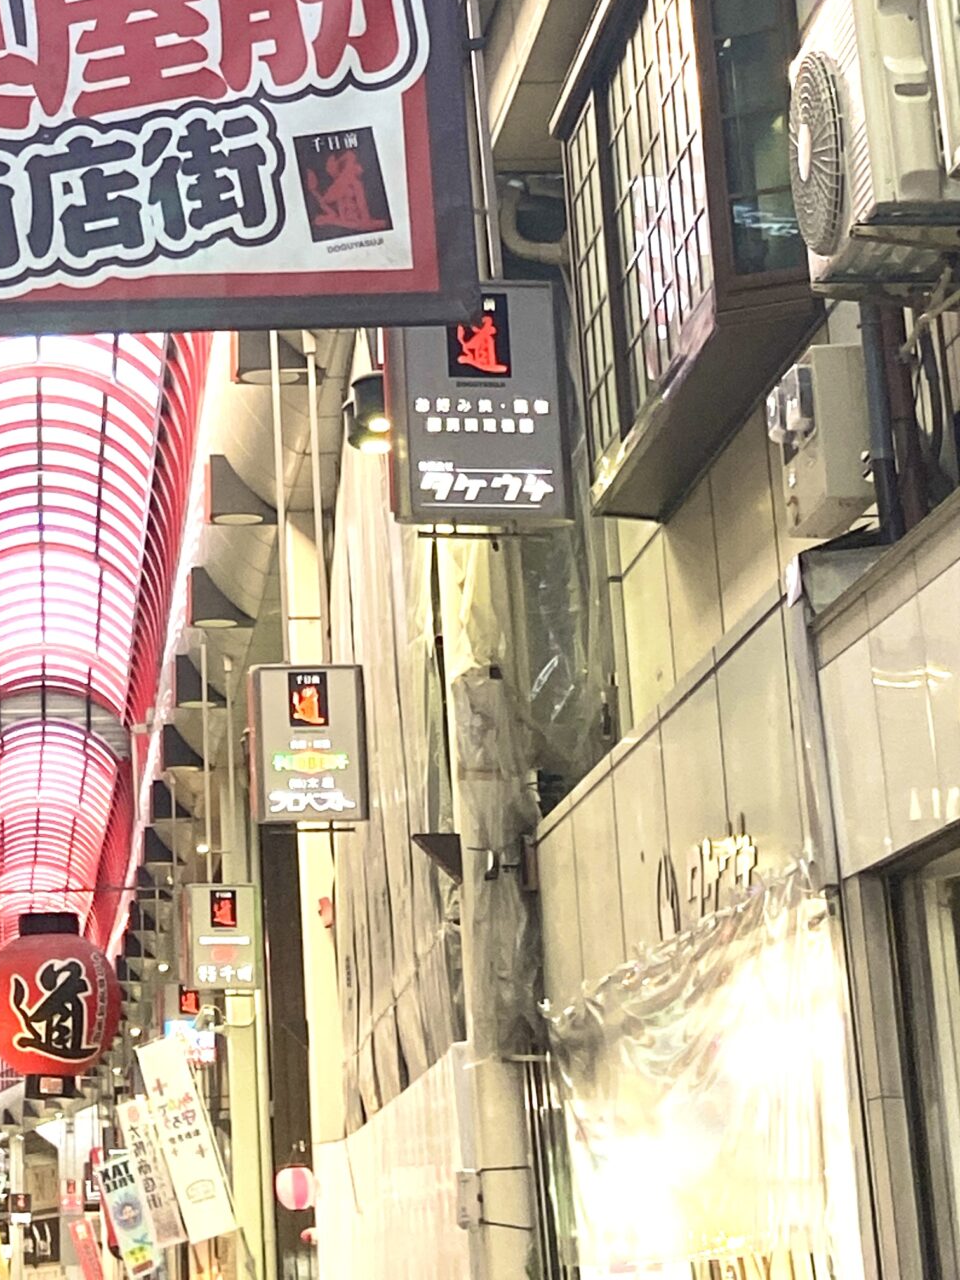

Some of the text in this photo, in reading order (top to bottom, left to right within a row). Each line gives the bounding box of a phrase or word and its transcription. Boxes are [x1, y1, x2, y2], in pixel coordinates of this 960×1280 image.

[312, 132, 359, 153] 千日前
[326, 237, 385, 254] DOGUYASUJI
[12, 958, 101, 1063] 道
